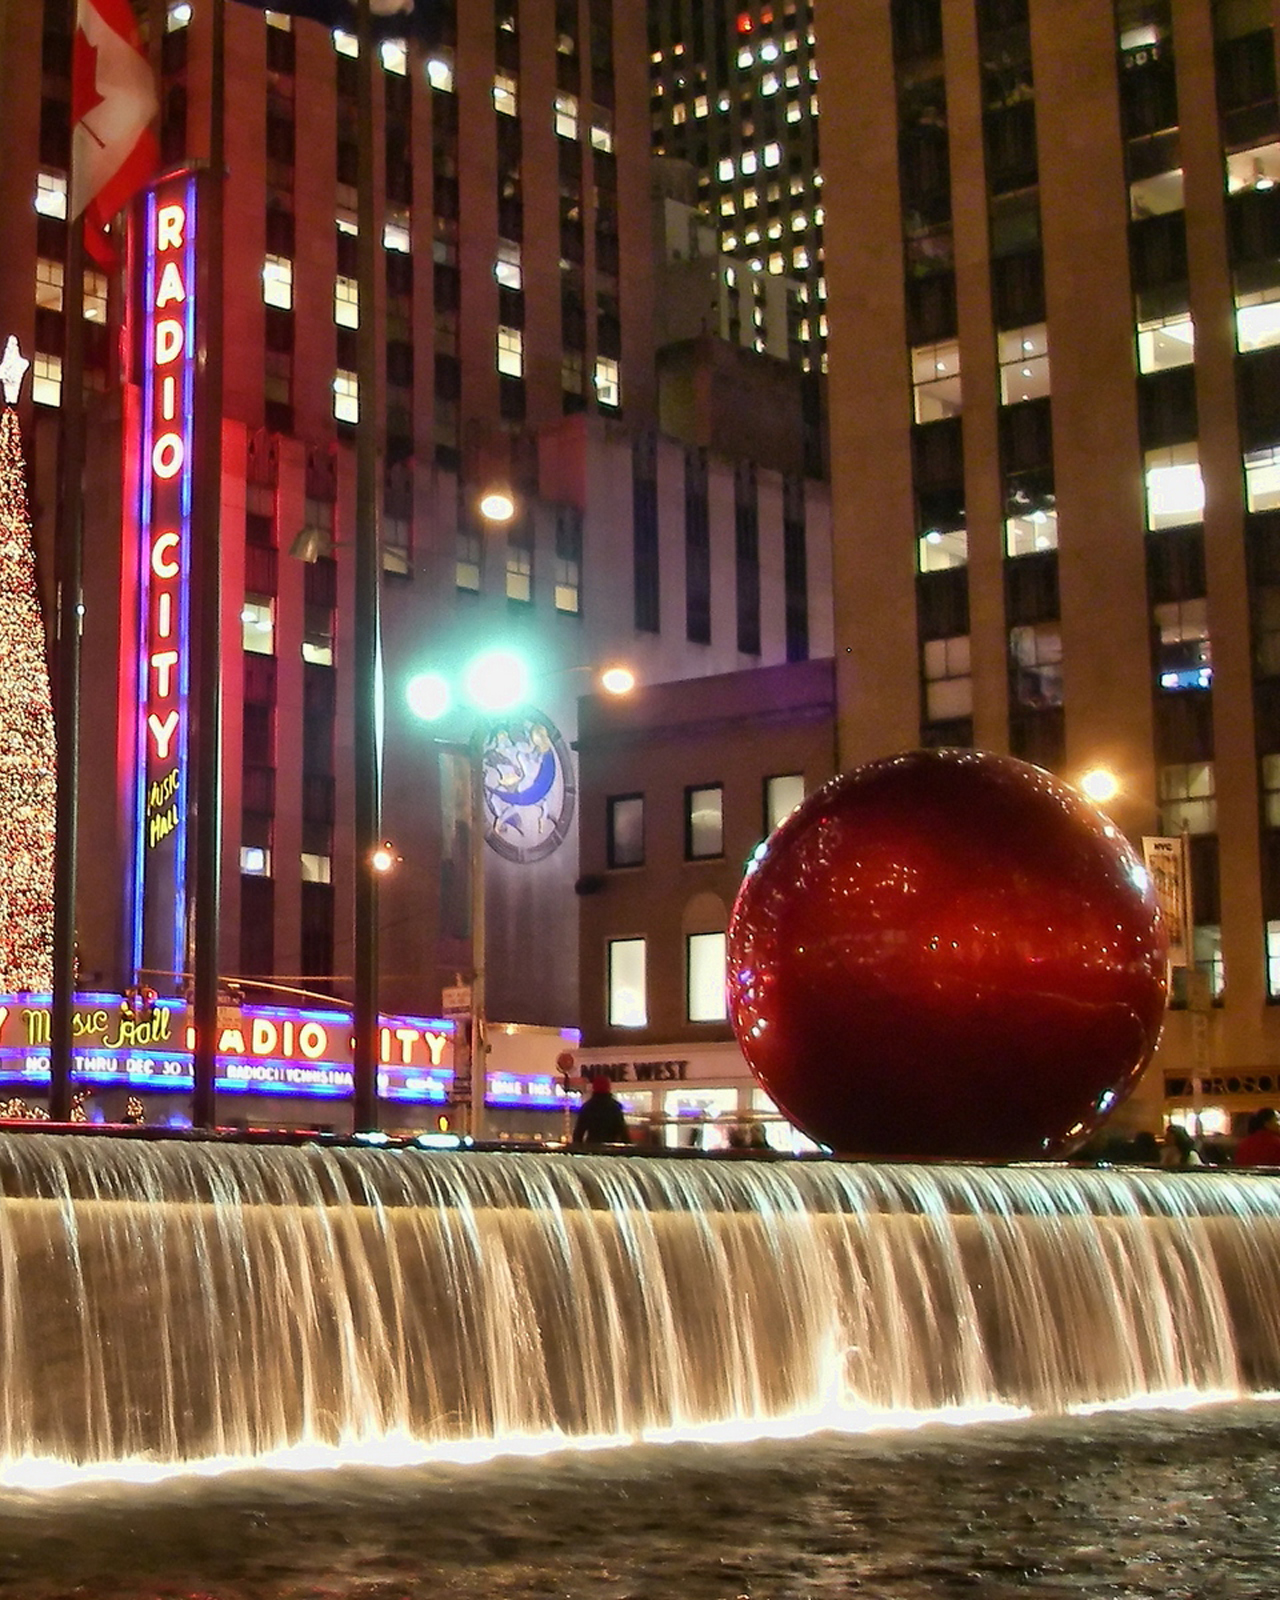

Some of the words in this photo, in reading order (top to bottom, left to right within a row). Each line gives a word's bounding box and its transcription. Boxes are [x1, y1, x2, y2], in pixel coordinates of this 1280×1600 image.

[150, 204, 186, 479] RADIO
[148, 532, 179, 759] CITY
[22, 1008, 109, 1046] Msic
[75, 1056, 118, 1072] THRU
[126, 1058, 153, 1075] DEC
[163, 1059, 182, 1075] 30
[350, 1027, 448, 1066] ITY
[580, 1062, 629, 1082] NINE
[633, 1060, 689, 1082] WEST
